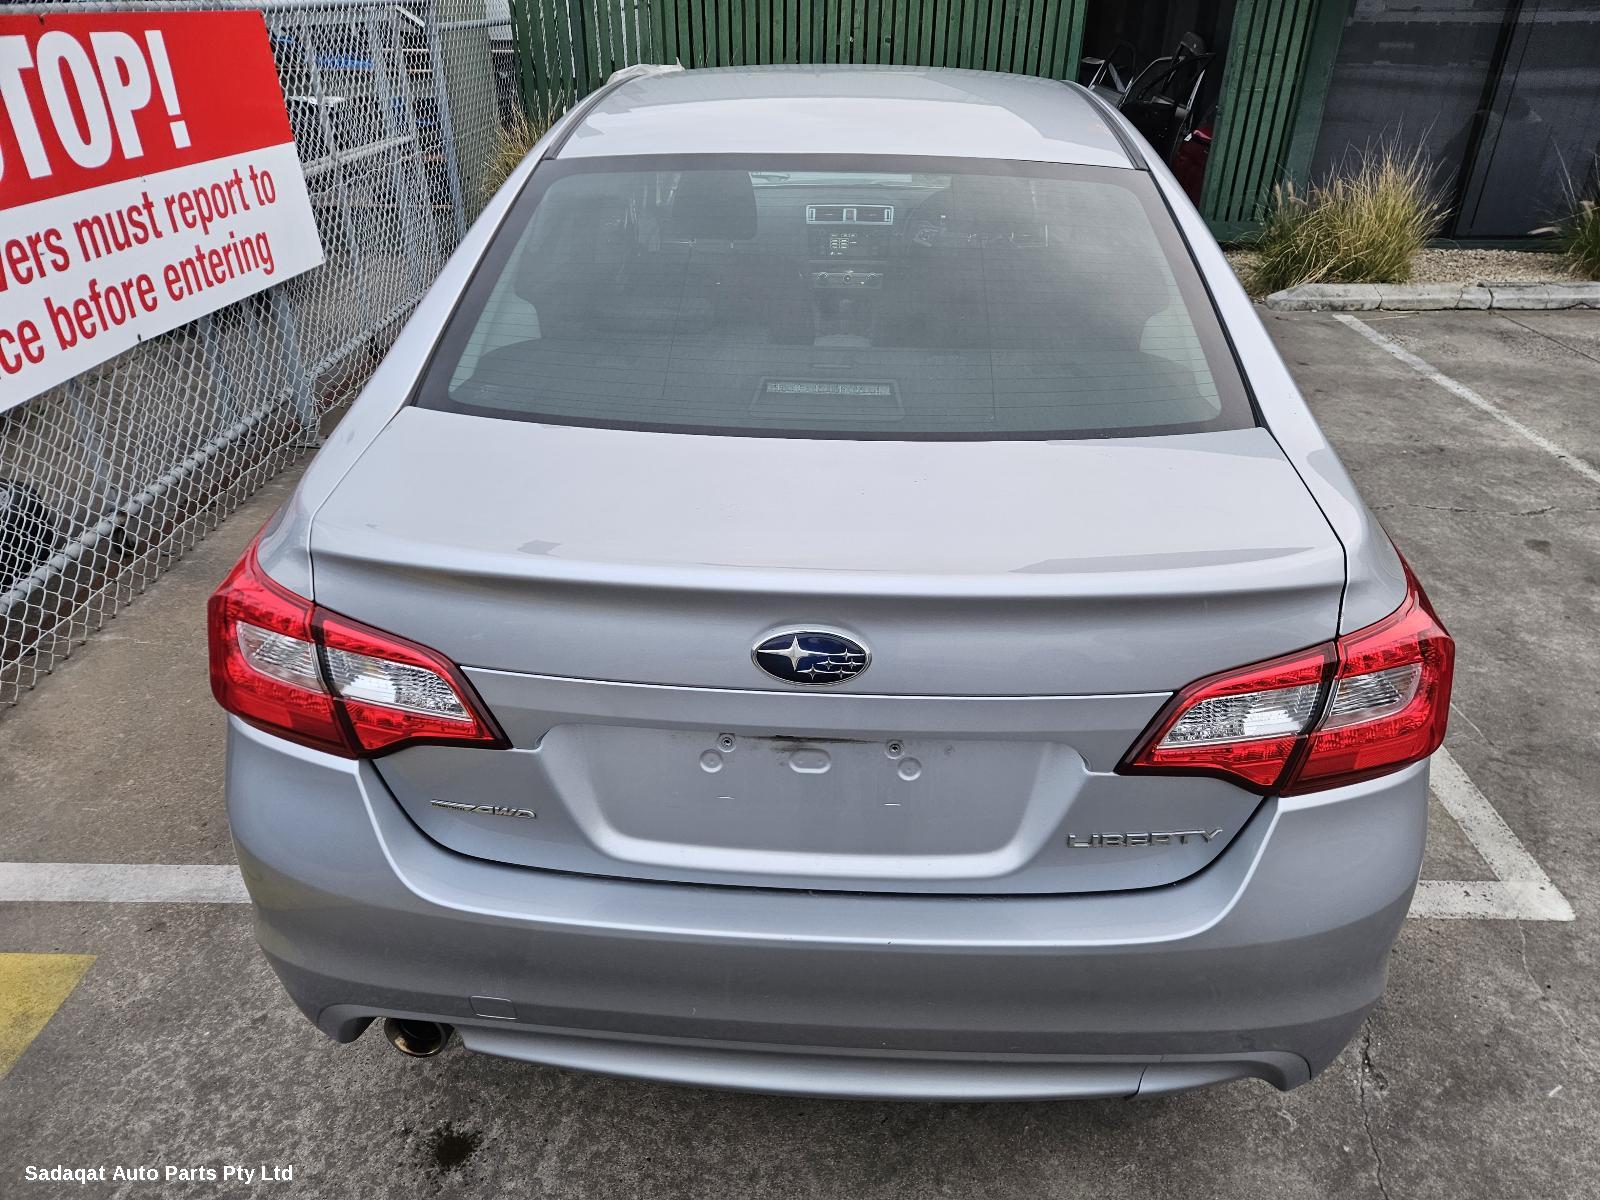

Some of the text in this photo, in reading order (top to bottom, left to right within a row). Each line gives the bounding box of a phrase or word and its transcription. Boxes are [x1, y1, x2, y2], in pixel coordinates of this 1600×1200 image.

[0, 30, 191, 179] TOP!
[74, 191, 163, 262] must
[165, 169, 250, 235] report
[249, 165, 276, 206] to
[0, 231, 275, 379] ce before entering
[1067, 829, 1223, 849] LIBERTY
